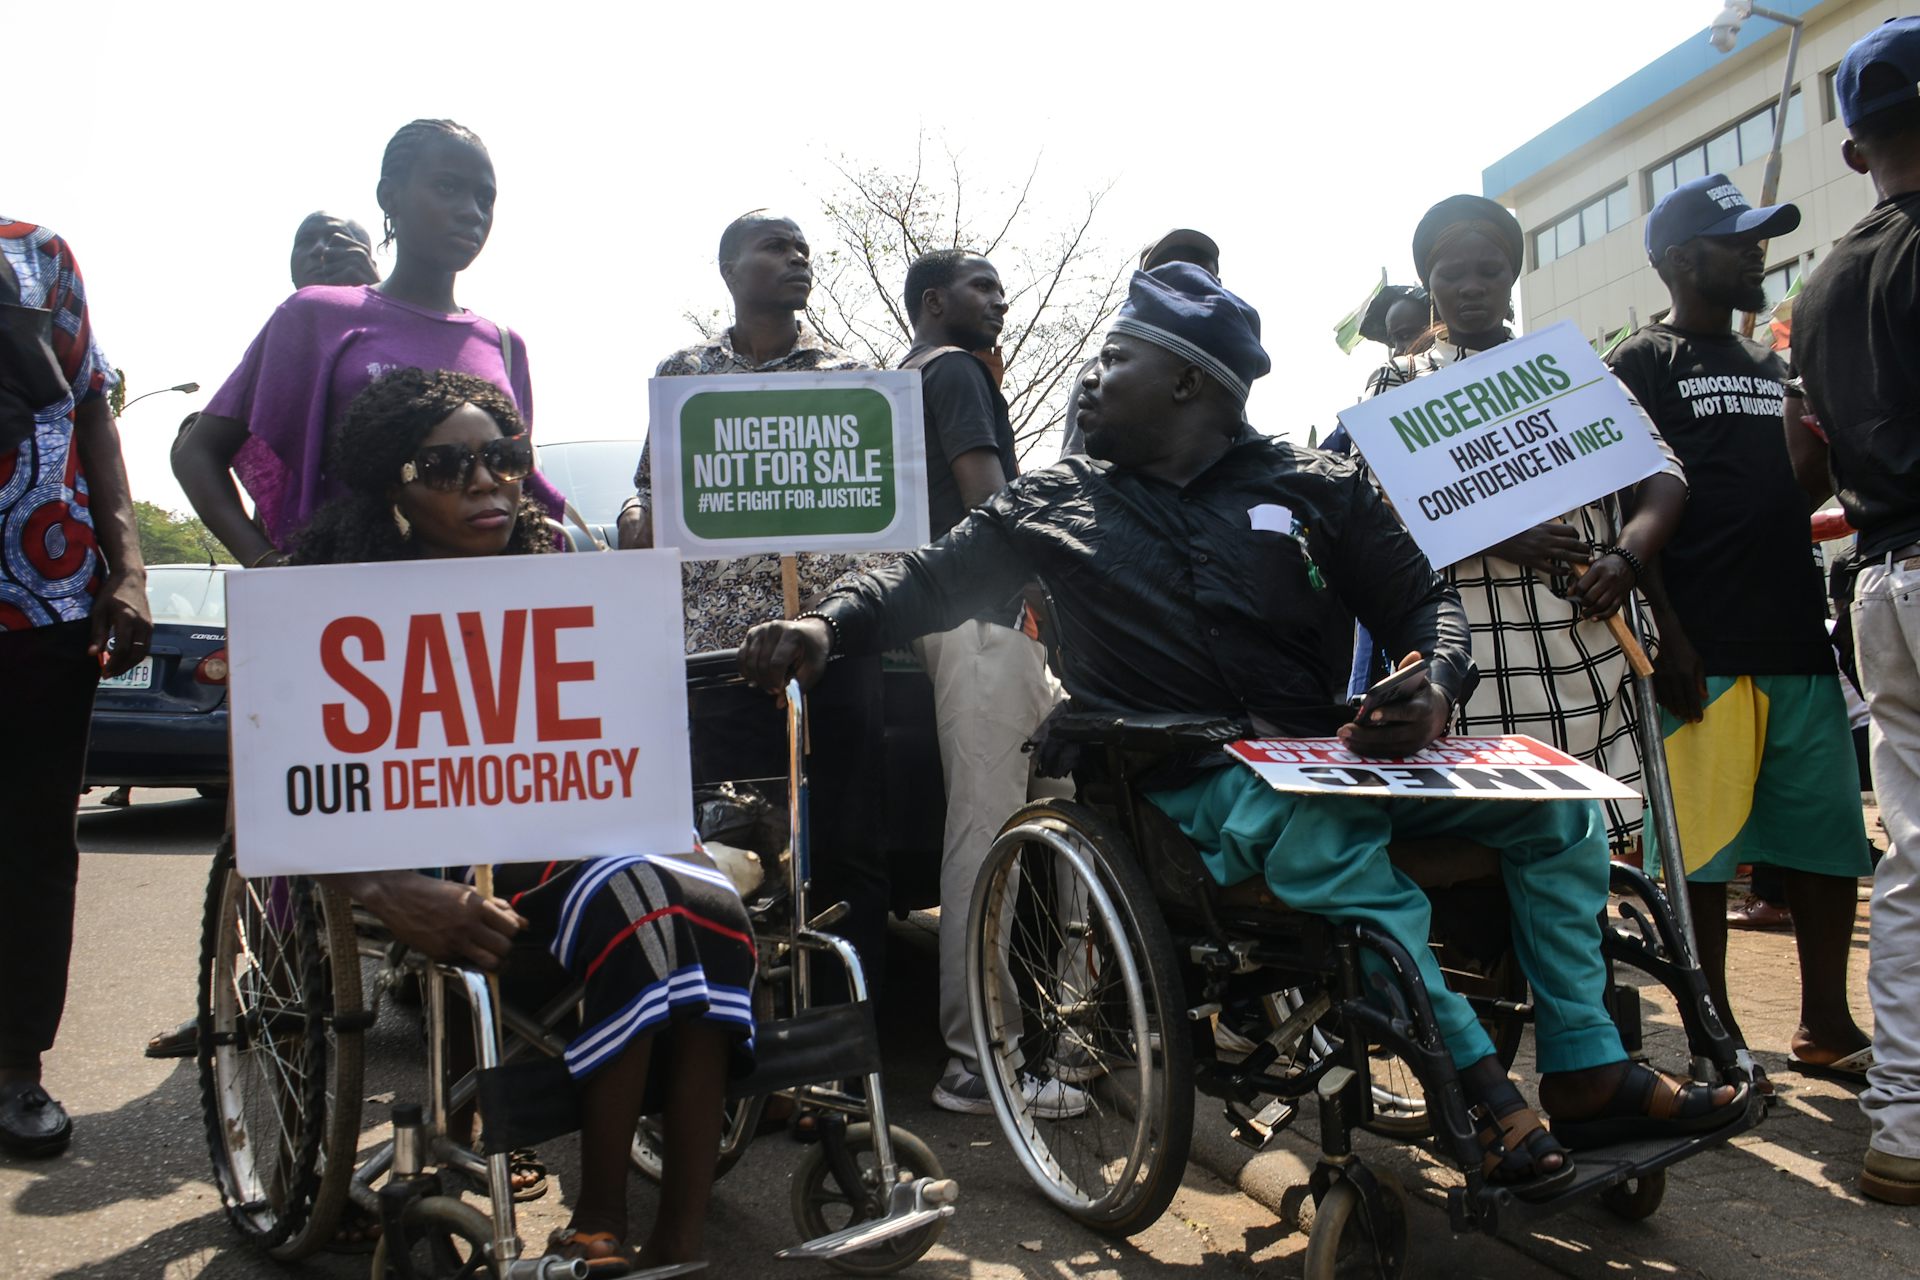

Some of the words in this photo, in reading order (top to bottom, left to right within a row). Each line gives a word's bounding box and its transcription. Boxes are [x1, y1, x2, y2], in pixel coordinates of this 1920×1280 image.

[1677, 375, 1753, 398] DEMOCRACY
[1753, 378, 1785, 399] SHOU
[1389, 353, 1572, 453] NIGERIANS
[1691, 397, 1722, 418] NOT
[1723, 395, 1741, 414] BE
[1741, 397, 1784, 418] MURDER
[714, 414, 860, 451] NIGERIANS
[1449, 430, 1503, 473] HAVE
[1502, 409, 1559, 451] LOST
[694, 452, 749, 488] NOT
[754, 450, 808, 486] FOR
[814, 449, 882, 484] SALE
[1418, 447, 1552, 521] CONFIDENCE
[1544, 437, 1576, 466] IN
[1569, 417, 1624, 456] INEC
[698, 492, 734, 513] #WE
[737, 490, 782, 511] FIGHT
[785, 489, 815, 510] FOR
[817, 487, 882, 509] JUSTICE
[190, 633, 227, 641] COROLL
[320, 605, 602, 754] SAVE
[1243, 740, 1348, 750] IGGIN
[1265, 751, 1328, 762] TO
[1432, 739, 1529, 750] ELECT
[287, 762, 371, 816] OUR
[383, 748, 640, 811] DEMOCRACY
[1298, 767, 1592, 790] INEC
